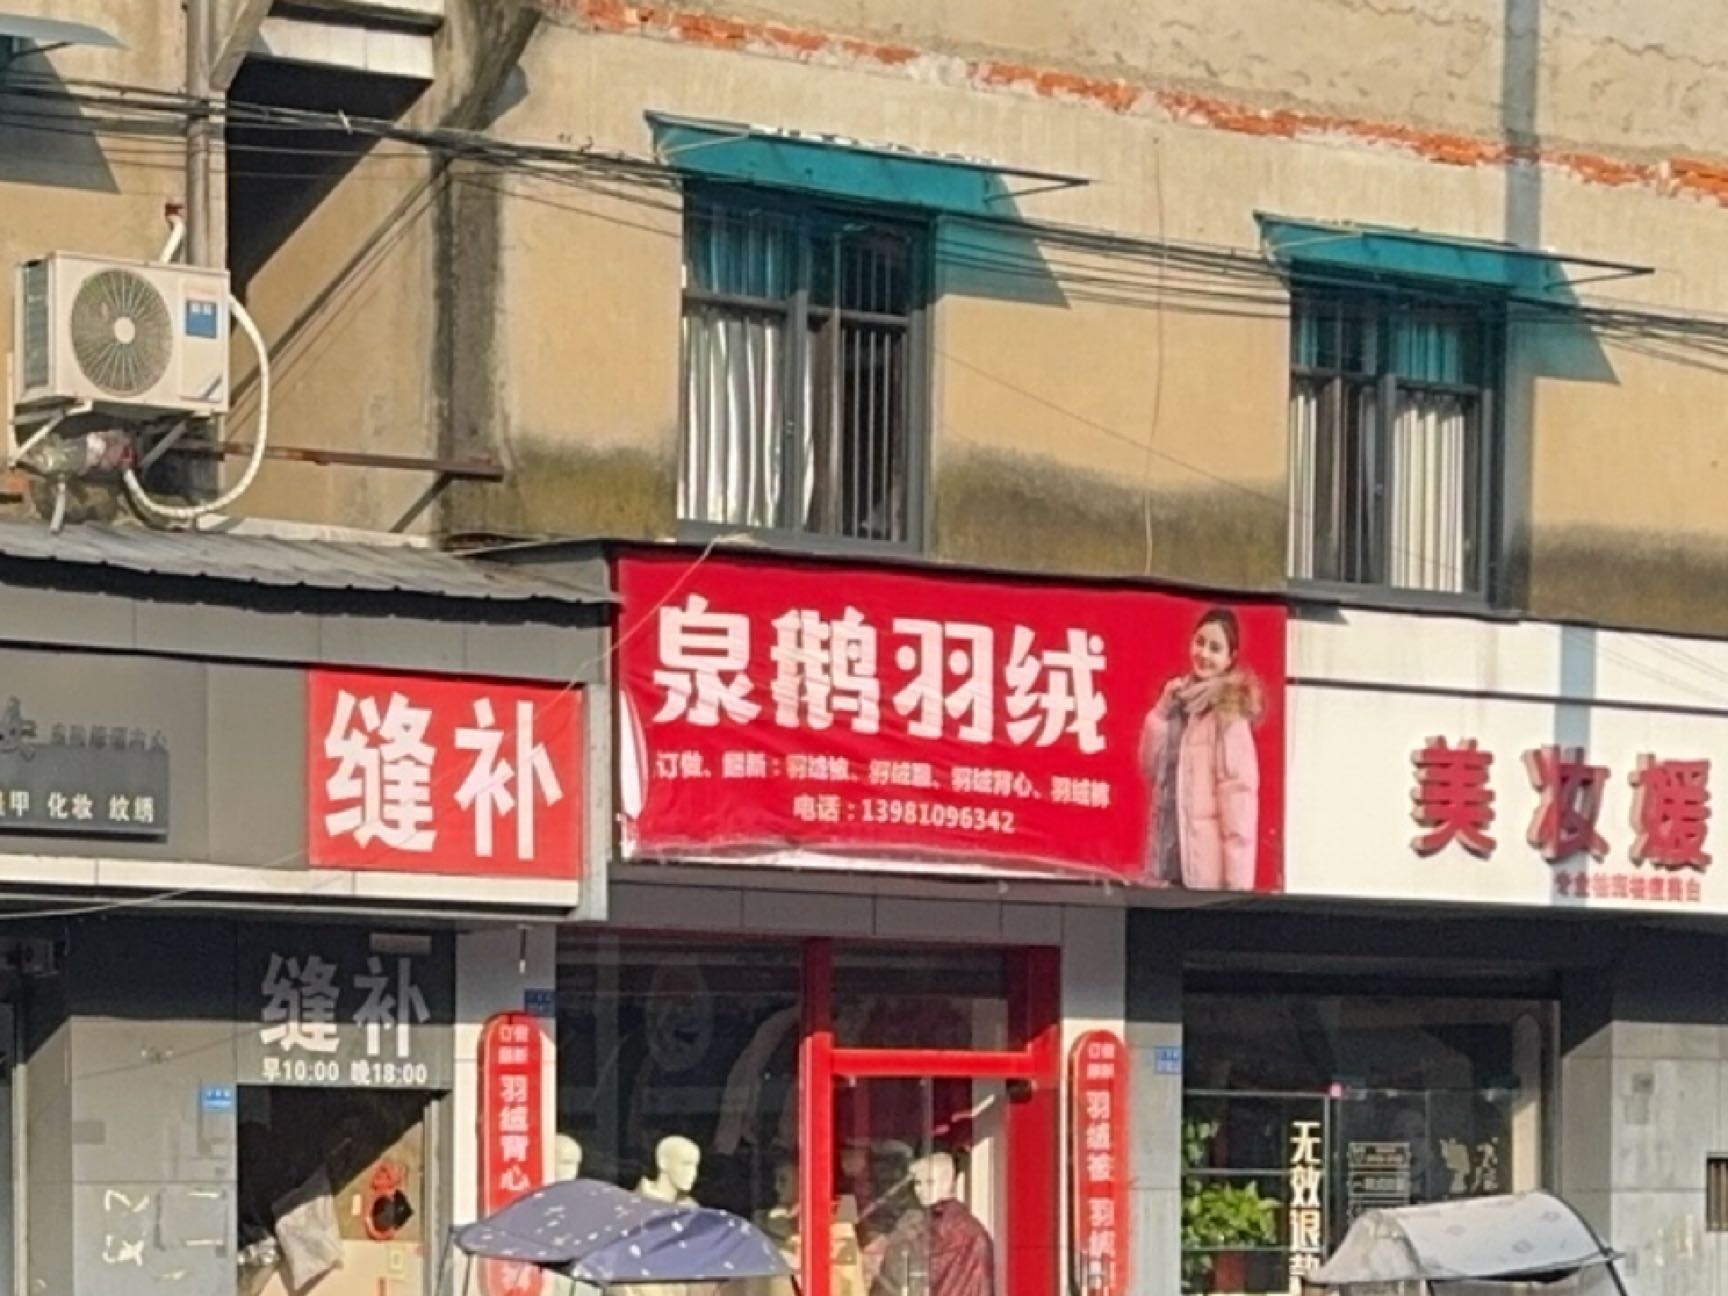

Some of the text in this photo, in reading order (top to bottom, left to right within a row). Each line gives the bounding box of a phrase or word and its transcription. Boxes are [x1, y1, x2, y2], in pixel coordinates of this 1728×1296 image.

[652, 593, 1110, 755] 泉鹅羽绒
[47, 792, 94, 820] 化妆
[323, 688, 565, 860] 缝补
[260, 952, 432, 1058] 缝补
[261, 1057, 340, 1083] 早10:00
